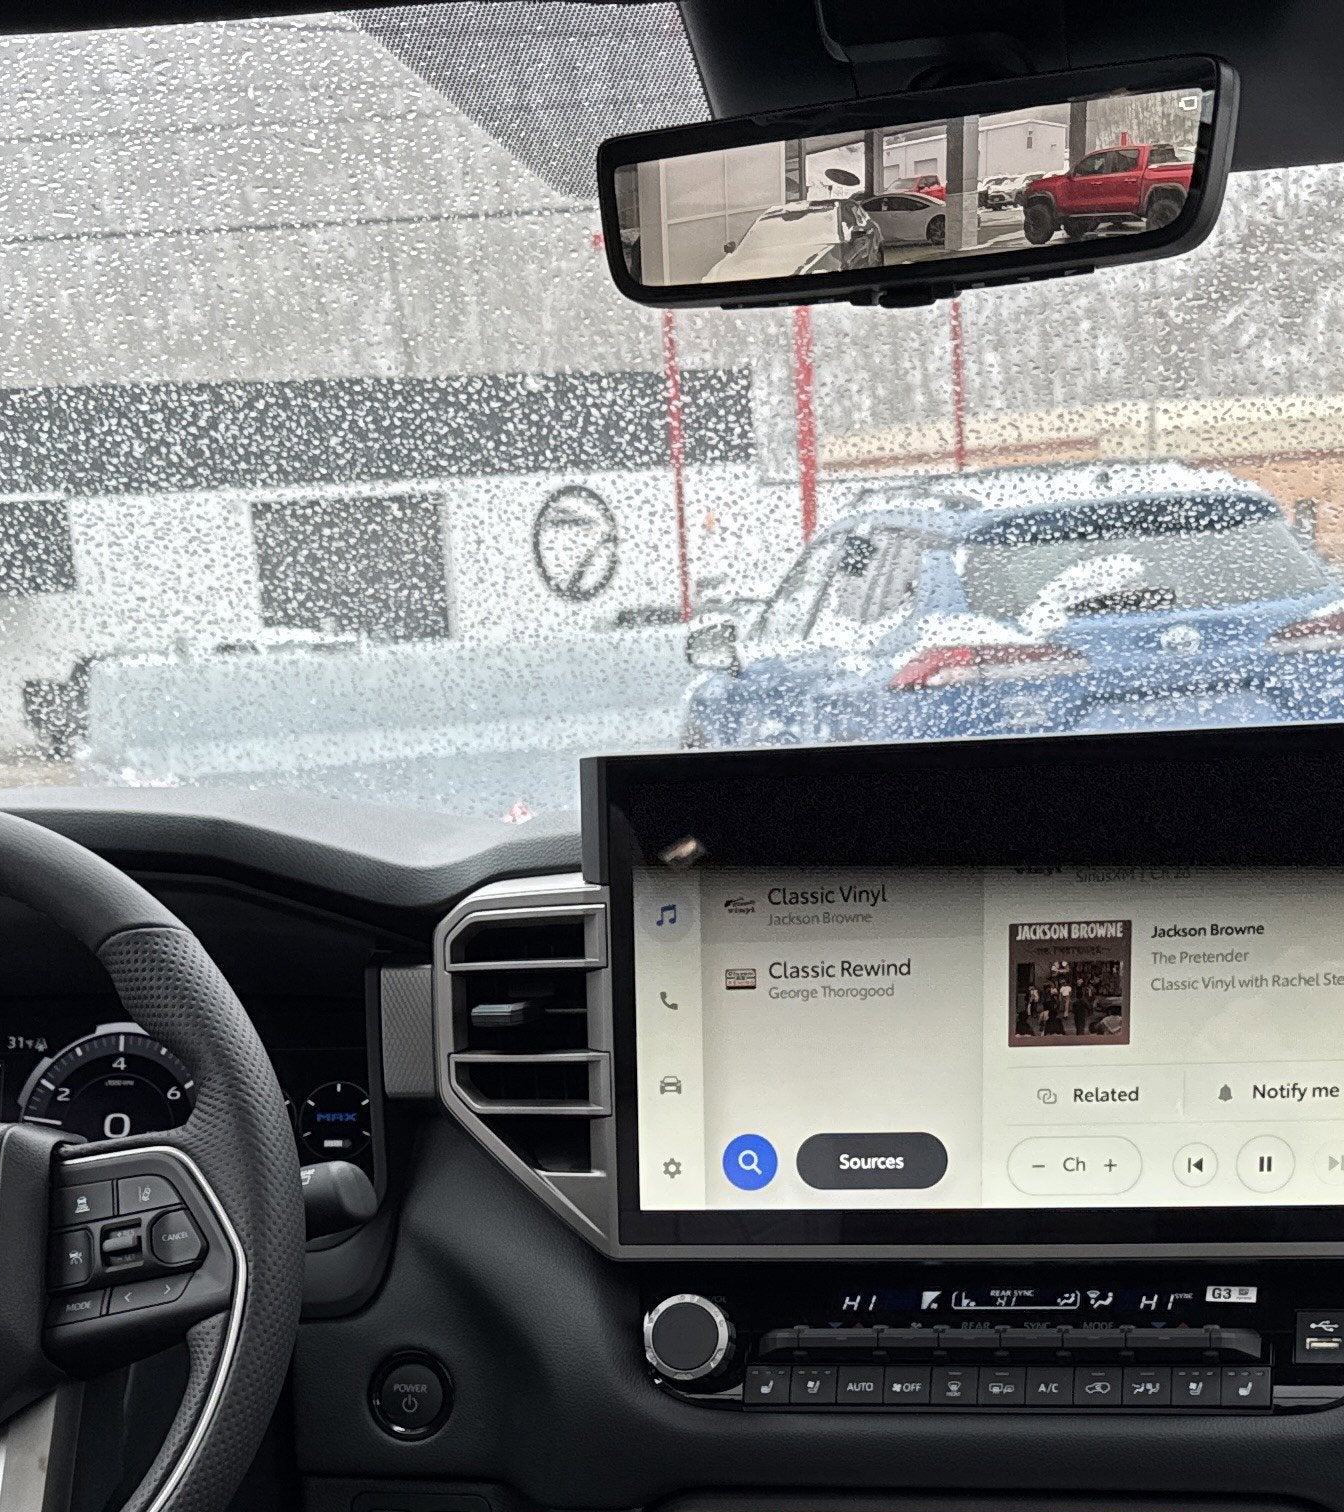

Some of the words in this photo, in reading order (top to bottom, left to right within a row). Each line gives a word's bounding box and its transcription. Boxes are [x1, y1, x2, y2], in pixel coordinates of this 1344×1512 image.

[768, 887, 835, 905] Classic
[840, 884, 888, 907] Vinyl
[768, 912, 820, 926] Jackson
[822, 911, 873, 924] Browne
[1016, 924, 1068, 940] JACKSON
[1071, 922, 1124, 939] BROWNE
[1151, 924, 1206, 938] Jackson
[1210, 923, 1265, 936] Browne
[1151, 951, 1177, 964] The
[1180, 949, 1250, 964] Pretender
[769, 961, 836, 979] Classic
[841, 958, 911, 978] Rewind
[1151, 977, 1199, 991] Classic
[1202, 976, 1236, 992] Vinyl
[1239, 974, 1269, 988] with
[1271, 972, 1320, 987] Rachel
[768, 986, 818, 1001] George
[821, 984, 895, 1000] Thorogood
[112, 1057, 127, 1070] 4
[56, 1088, 70, 1101] 2
[166, 1086, 181, 1100] 6
[1073, 1087, 1140, 1102] Related
[1253, 1083, 1308, 1102] Notify
[1312, 1085, 1340, 1098] me
[104, 1112, 131, 1139] 0
[839, 1153, 905, 1169] Sources
[1063, 1157, 1086, 1172] Ch
[162, 1231, 189, 1242] CANCEL
[1211, 1287, 1232, 1300] G3
[842, 1295, 877, 1311] HI
[1140, 1294, 1174, 1311] HI
[961, 1321, 991, 1330] REAR
[1023, 1321, 1052, 1330] SYNC
[393, 1383, 428, 1394] POWER
[846, 1382, 874, 1392] AUTO
[903, 1383, 922, 1392] OFF
[1038, 1383, 1059, 1393] A/C
